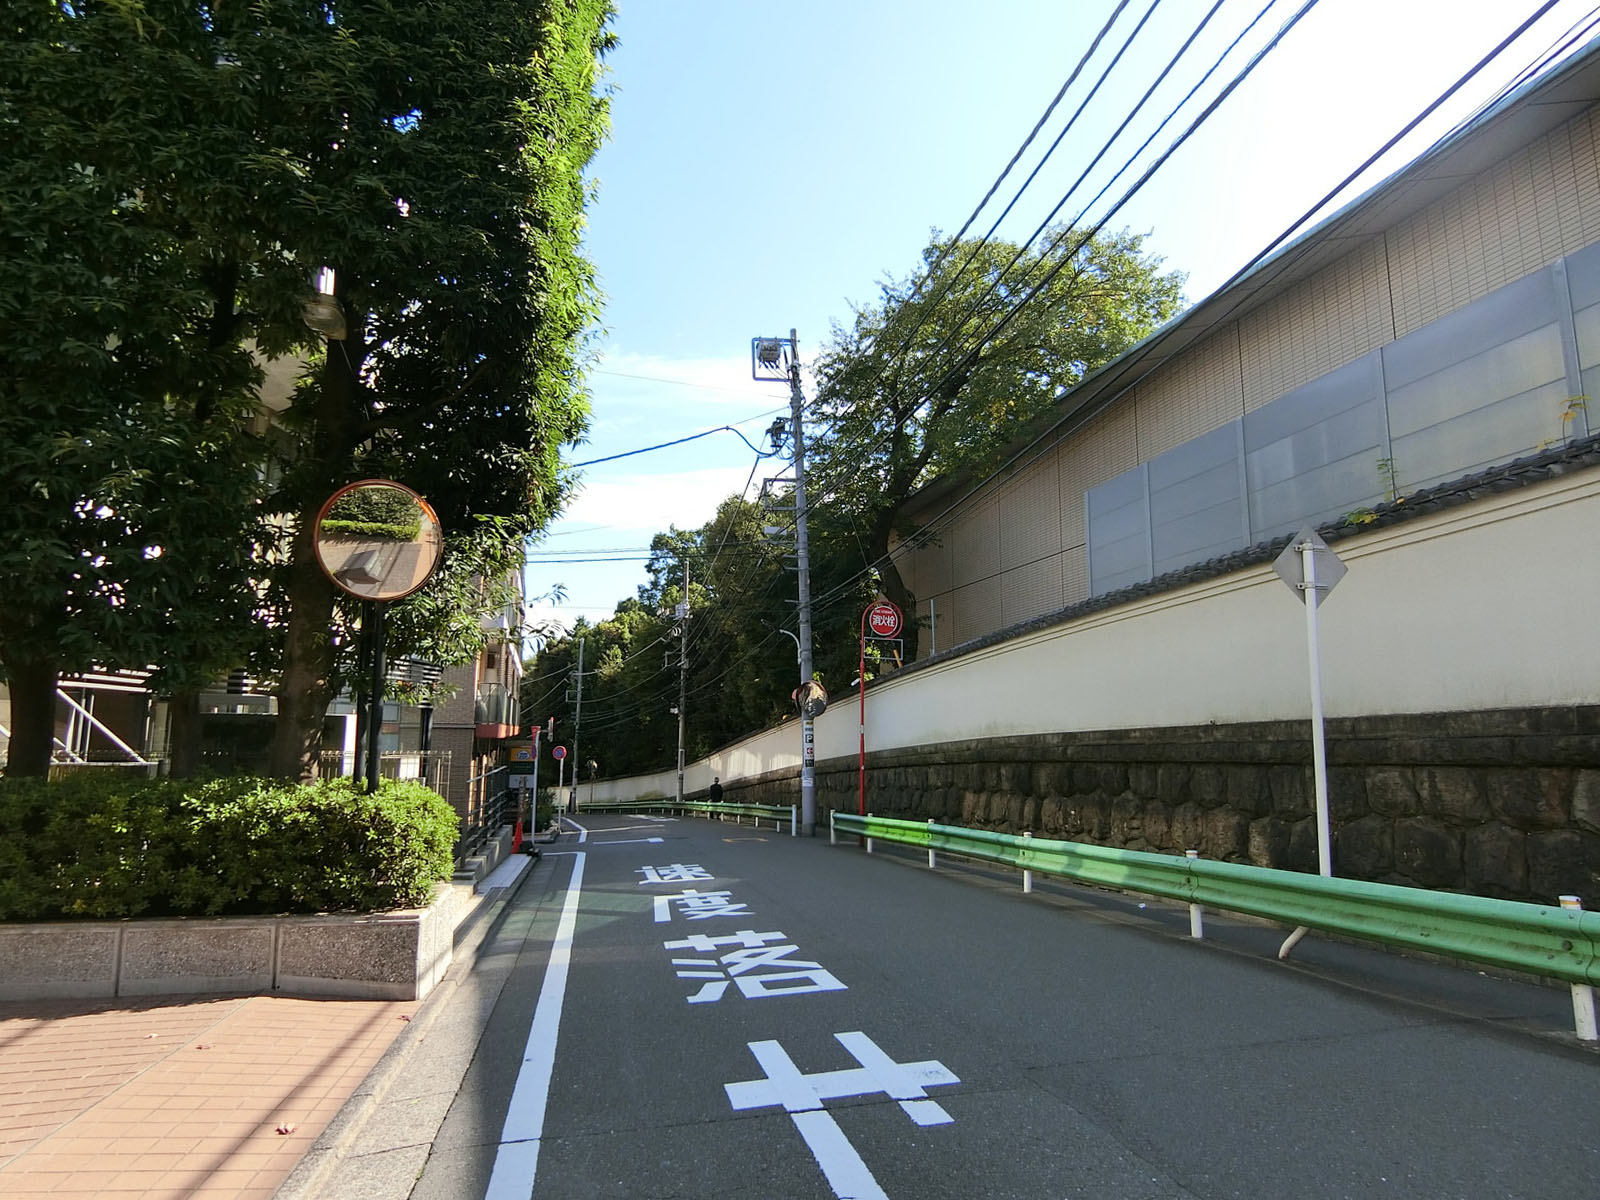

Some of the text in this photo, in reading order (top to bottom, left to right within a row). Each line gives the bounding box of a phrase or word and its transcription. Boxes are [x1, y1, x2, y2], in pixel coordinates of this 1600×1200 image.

[872, 614, 895, 627] 消火栓
[806, 734, 813, 743] P
